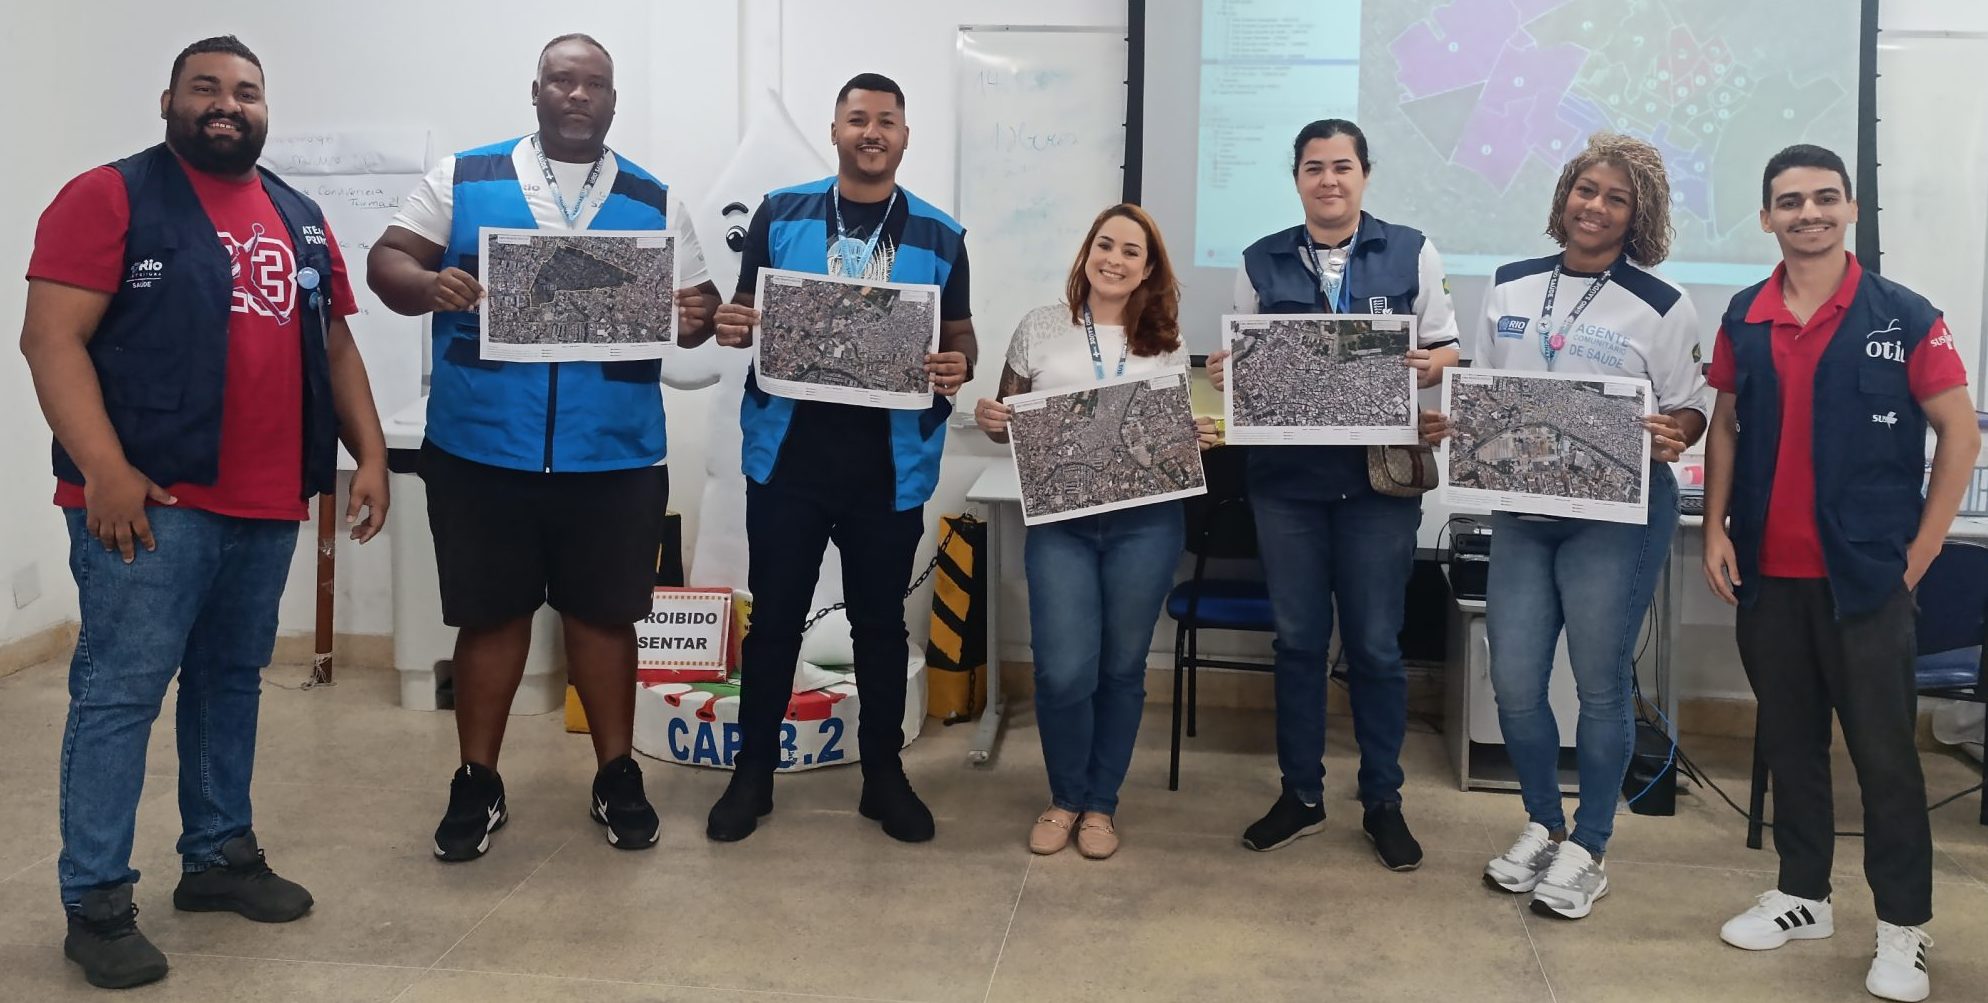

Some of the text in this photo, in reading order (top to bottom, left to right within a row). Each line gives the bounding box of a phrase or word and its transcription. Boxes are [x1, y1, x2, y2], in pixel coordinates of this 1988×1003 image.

[1508, 320, 1526, 329] RIO
[1575, 323, 1630, 347] AGENTE
[1569, 343, 1584, 357] DE
[643, 611, 718, 625] ROIBIDO
[638, 636, 708, 650] SENTAR
[667, 717, 743, 767] CAP
